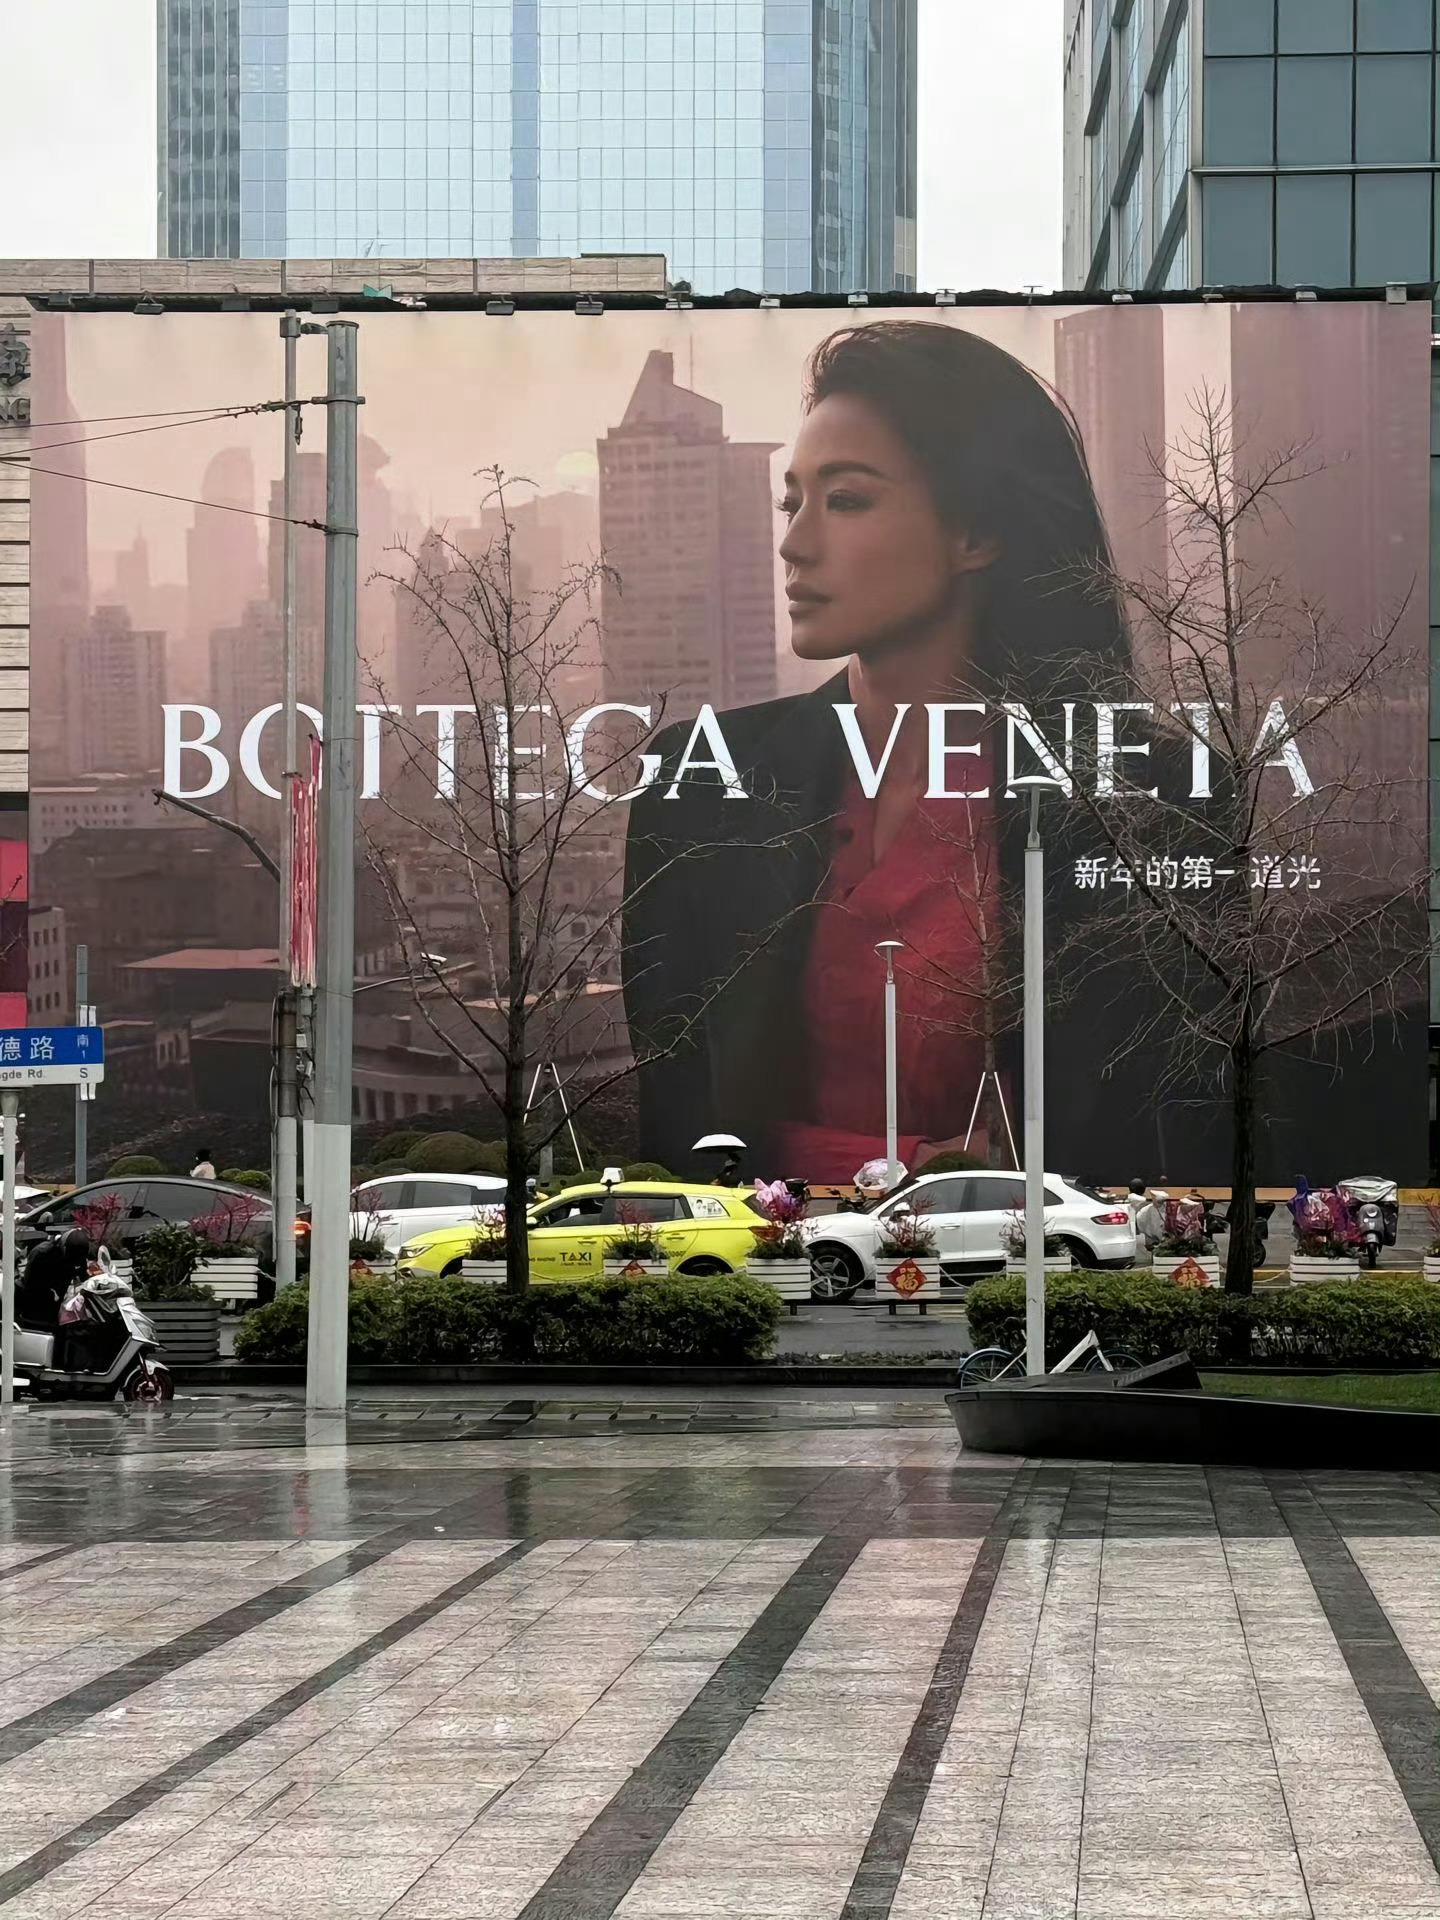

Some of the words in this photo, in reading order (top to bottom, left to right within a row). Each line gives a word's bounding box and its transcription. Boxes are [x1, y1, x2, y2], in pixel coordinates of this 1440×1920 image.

[161, 702, 749, 800] BOTTEGA
[832, 700, 1316, 799] VENETA
[1074, 855, 1321, 890] 新年的第一道光
[80, 1067, 88, 1079] S
[559, 1251, 592, 1262] TAXI
[895, 1267, 919, 1290] 福
